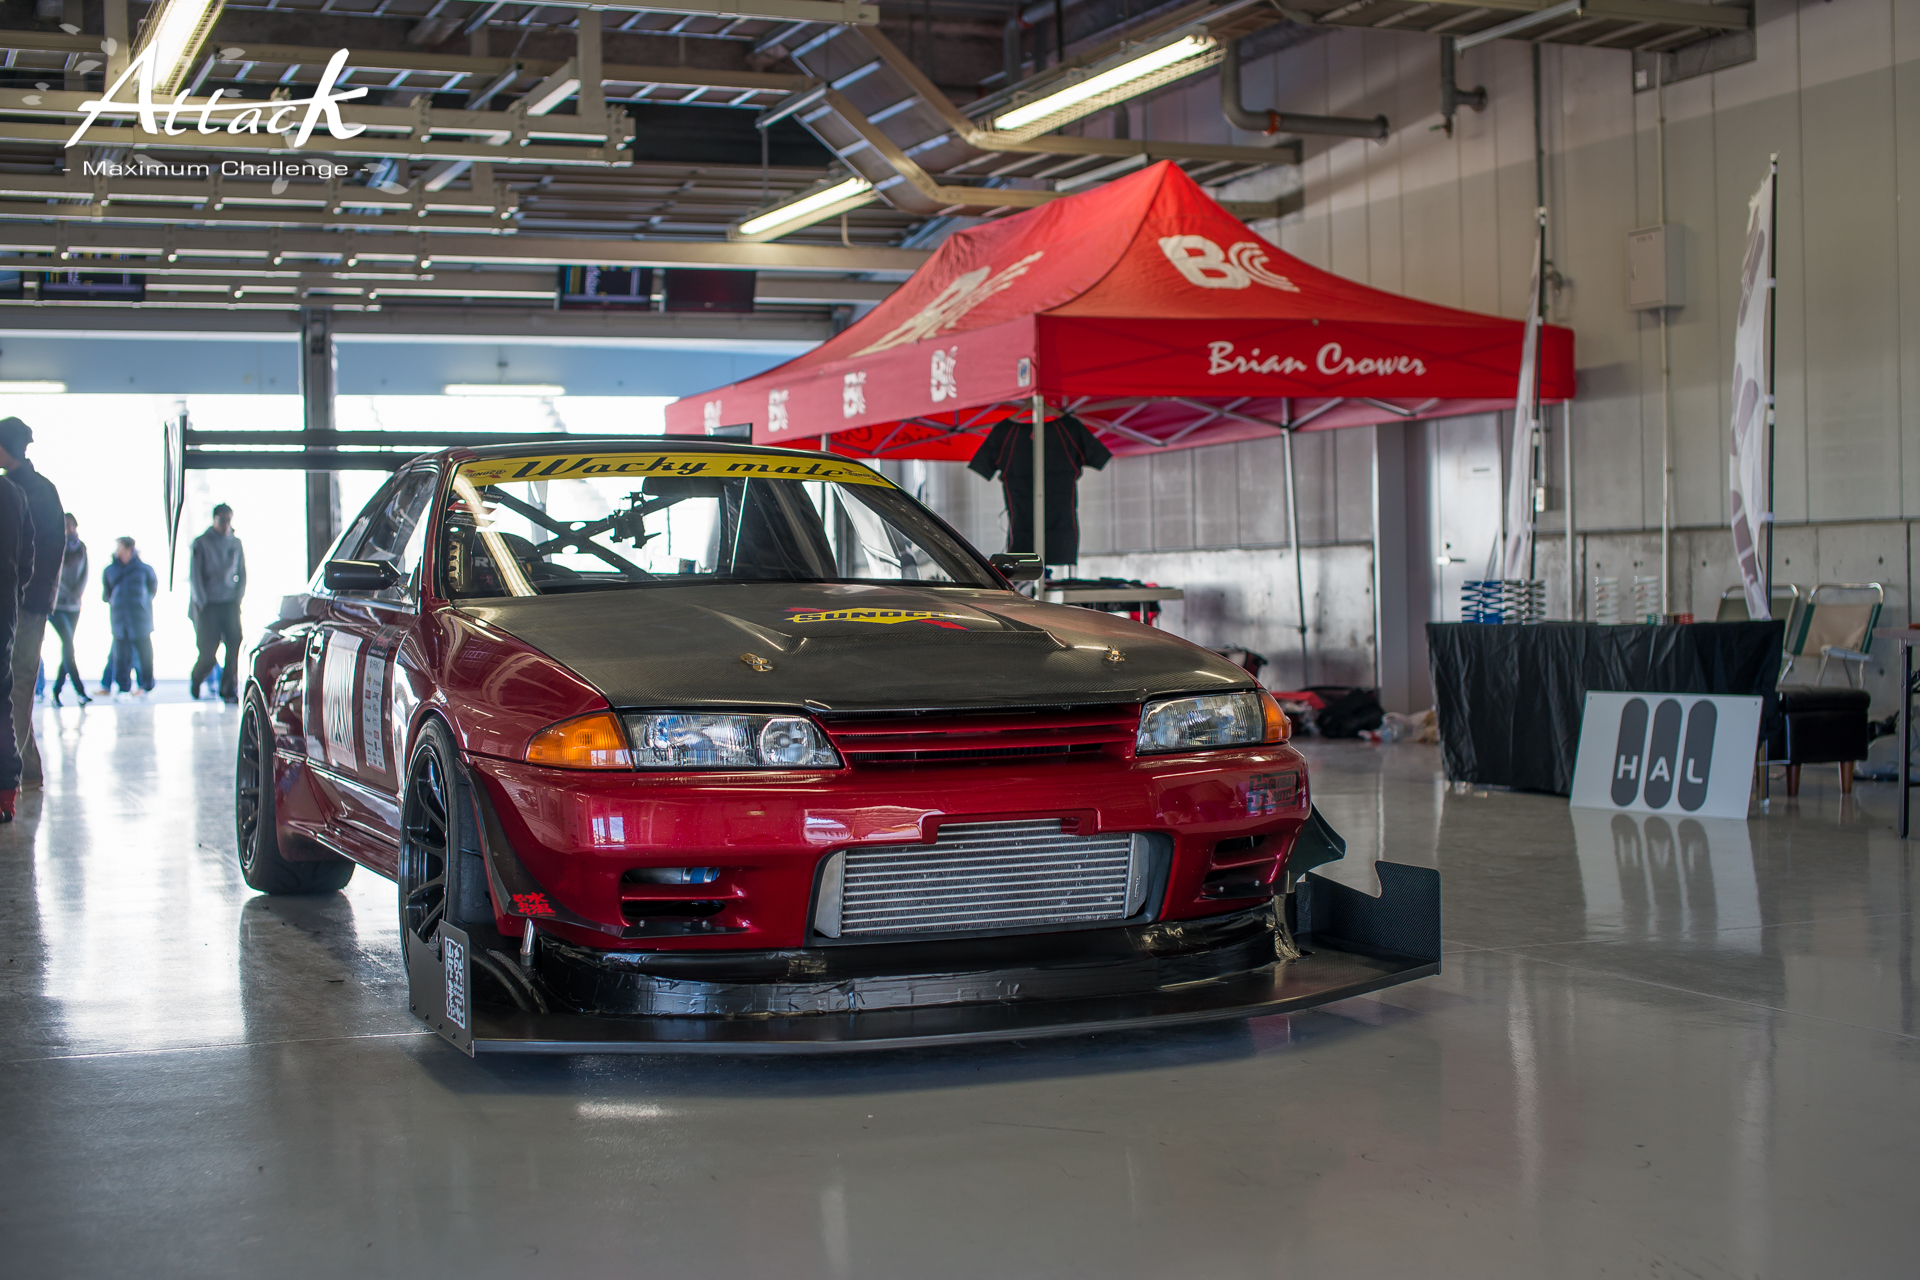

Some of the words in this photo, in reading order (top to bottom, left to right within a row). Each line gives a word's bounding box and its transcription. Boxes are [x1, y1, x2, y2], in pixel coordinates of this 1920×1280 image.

[1207, 341, 1307, 375] Brian
[1315, 342, 1427, 376] Crower
[504, 456, 711, 478] Wacky
[726, 463, 843, 477] mate
[1617, 755, 1703, 784] HAL
[1269, 776, 1295, 790] GLOBAL
[1271, 789, 1292, 802] AUTO
